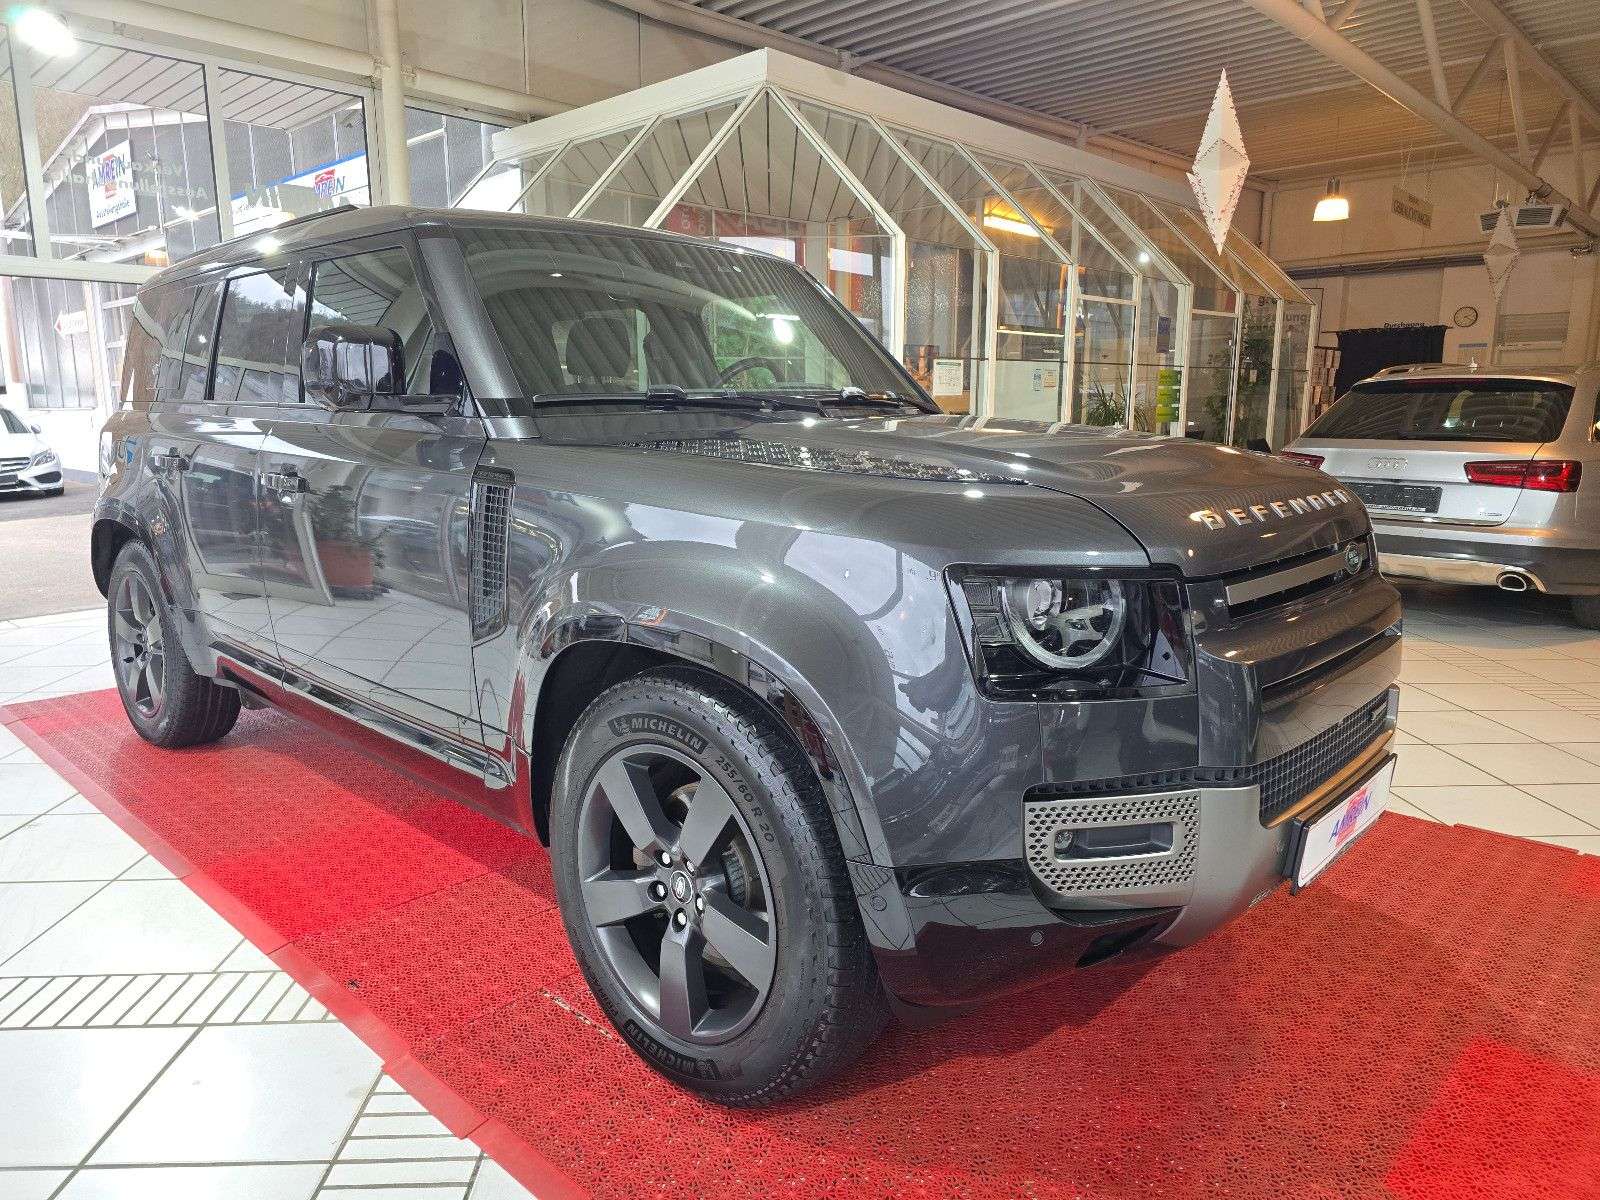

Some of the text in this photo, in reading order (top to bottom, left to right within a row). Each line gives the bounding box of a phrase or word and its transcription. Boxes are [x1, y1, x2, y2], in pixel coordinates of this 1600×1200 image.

[1199, 488, 1351, 531] DEFENDER
[631, 717, 704, 750] MICHELIN
[714, 755, 775, 843] 255/60 R 20
[627, 1023, 695, 1073] MICHELIN
